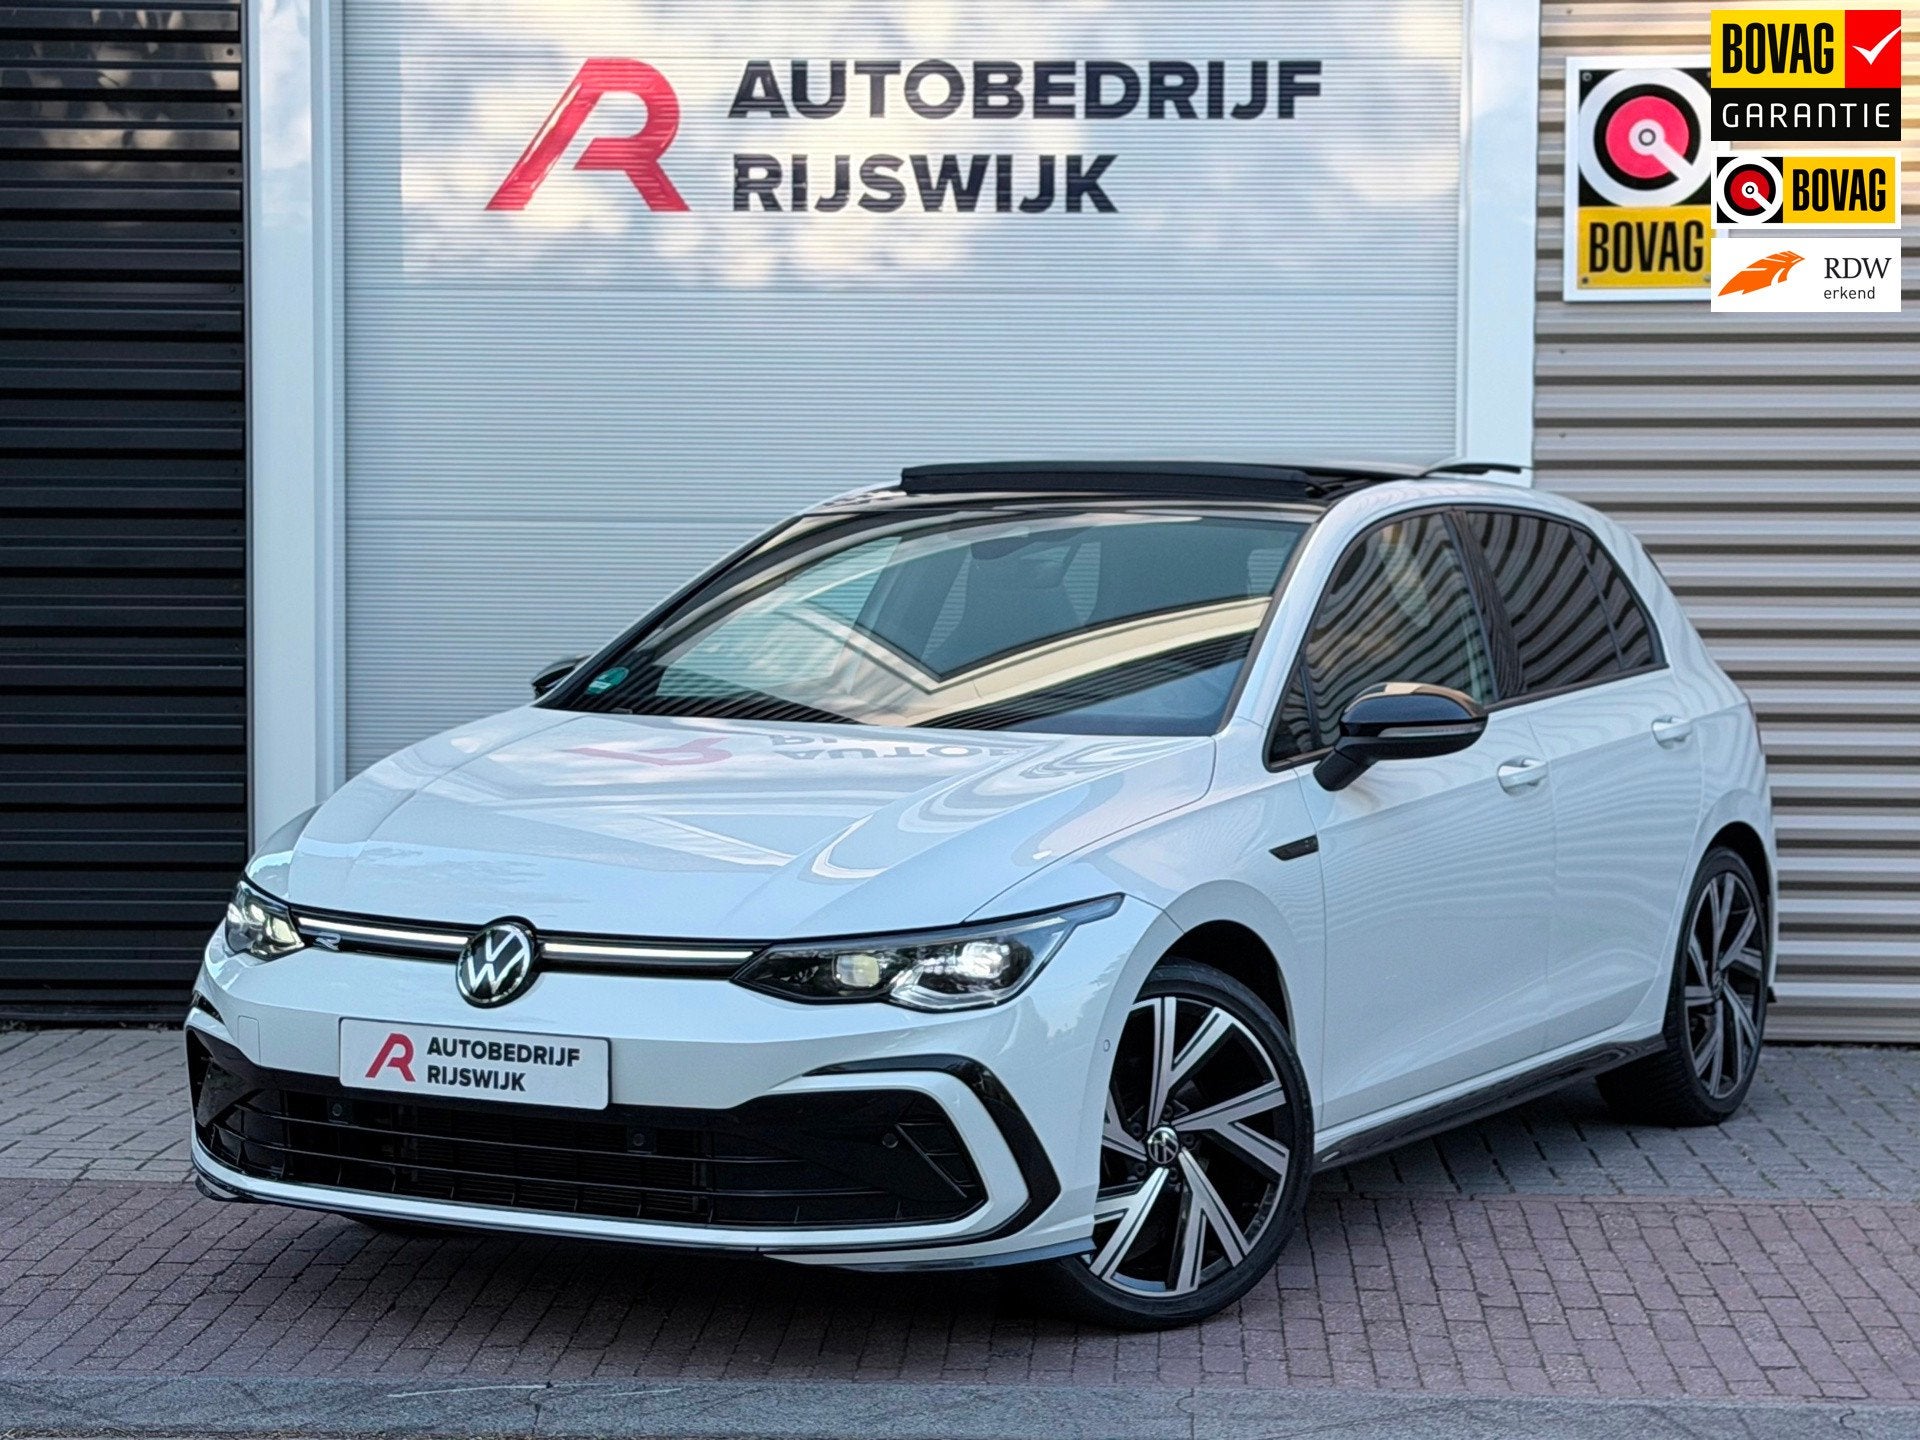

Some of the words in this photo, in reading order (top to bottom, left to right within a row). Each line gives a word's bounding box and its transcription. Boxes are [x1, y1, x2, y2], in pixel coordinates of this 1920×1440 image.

[728, 59, 1323, 120] AUTOBEDRIJF
[731, 153, 1119, 214] RIJSWIJK
[1588, 220, 1704, 273] BOVAG
[426, 1036, 580, 1067] AUTOBEDRIJF
[427, 1065, 526, 1091] RIJSWIJK
